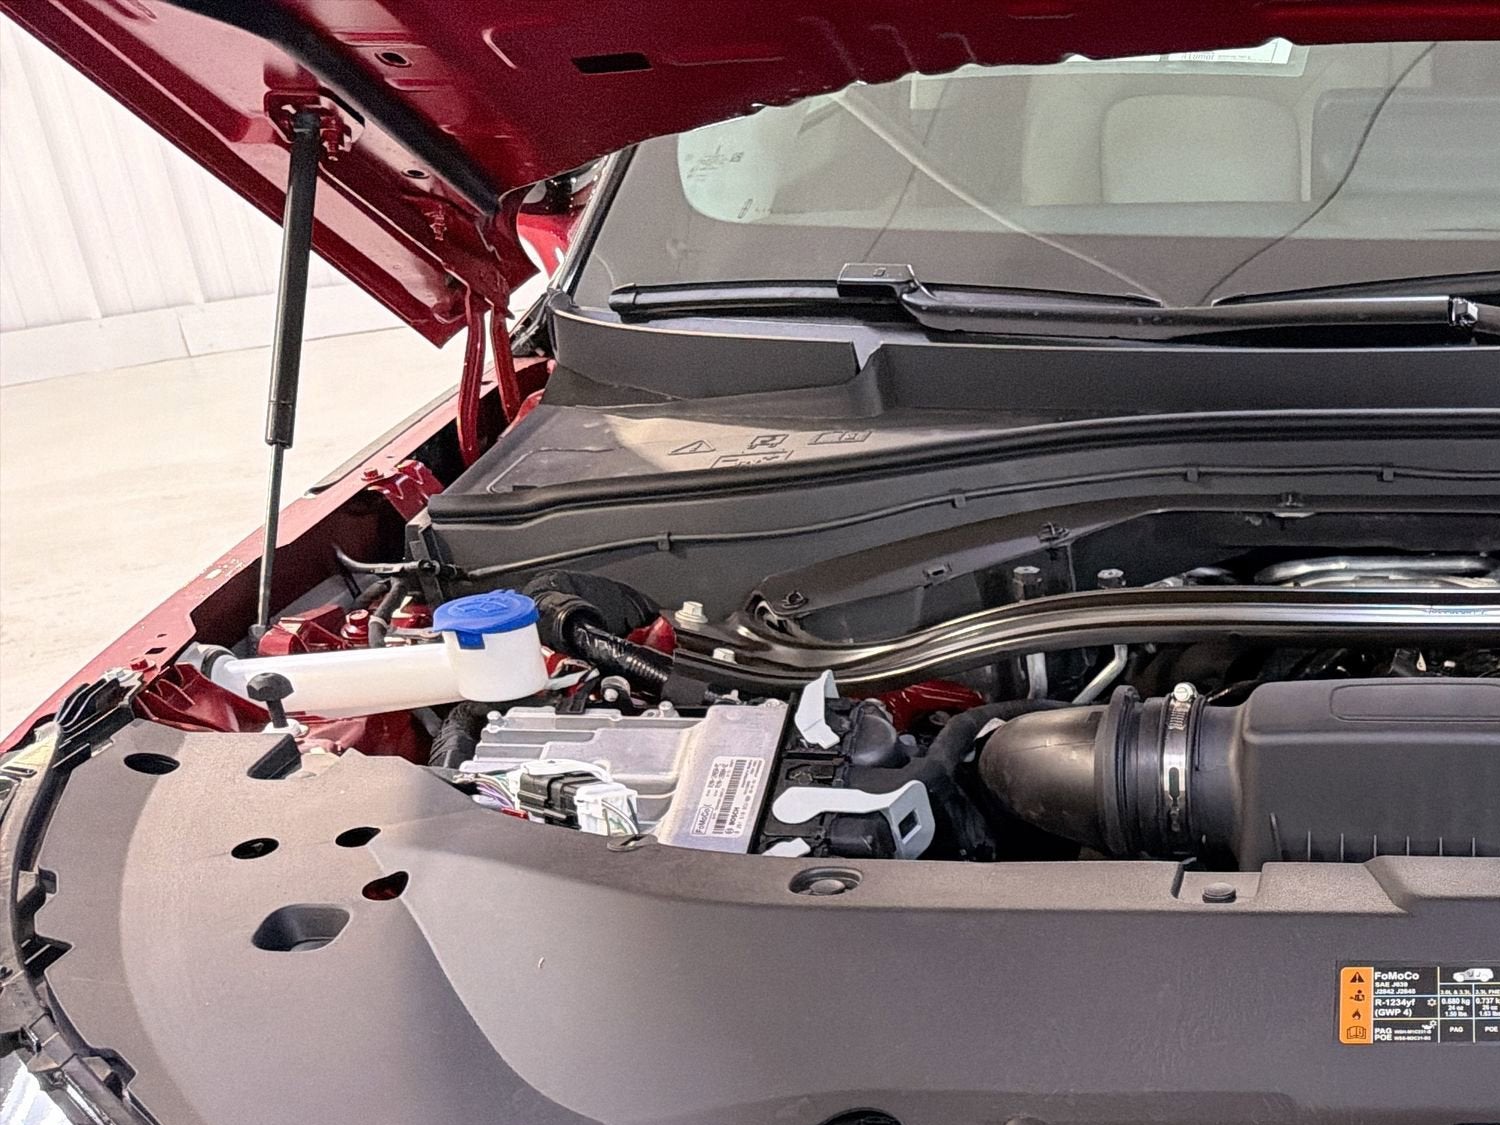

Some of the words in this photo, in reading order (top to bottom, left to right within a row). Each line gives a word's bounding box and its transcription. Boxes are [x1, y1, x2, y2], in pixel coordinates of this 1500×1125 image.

[696, 808, 711, 833] FoMoCo
[729, 807, 740, 826] BOSCH
[1374, 971, 1420, 980] FoMoCo
[1375, 999, 1415, 1007] R-1234yf
[1461, 998, 1471, 1006] kg
[1374, 1009, 1401, 1017] (GWP
[1403, 1009, 1412, 1017] 4)
